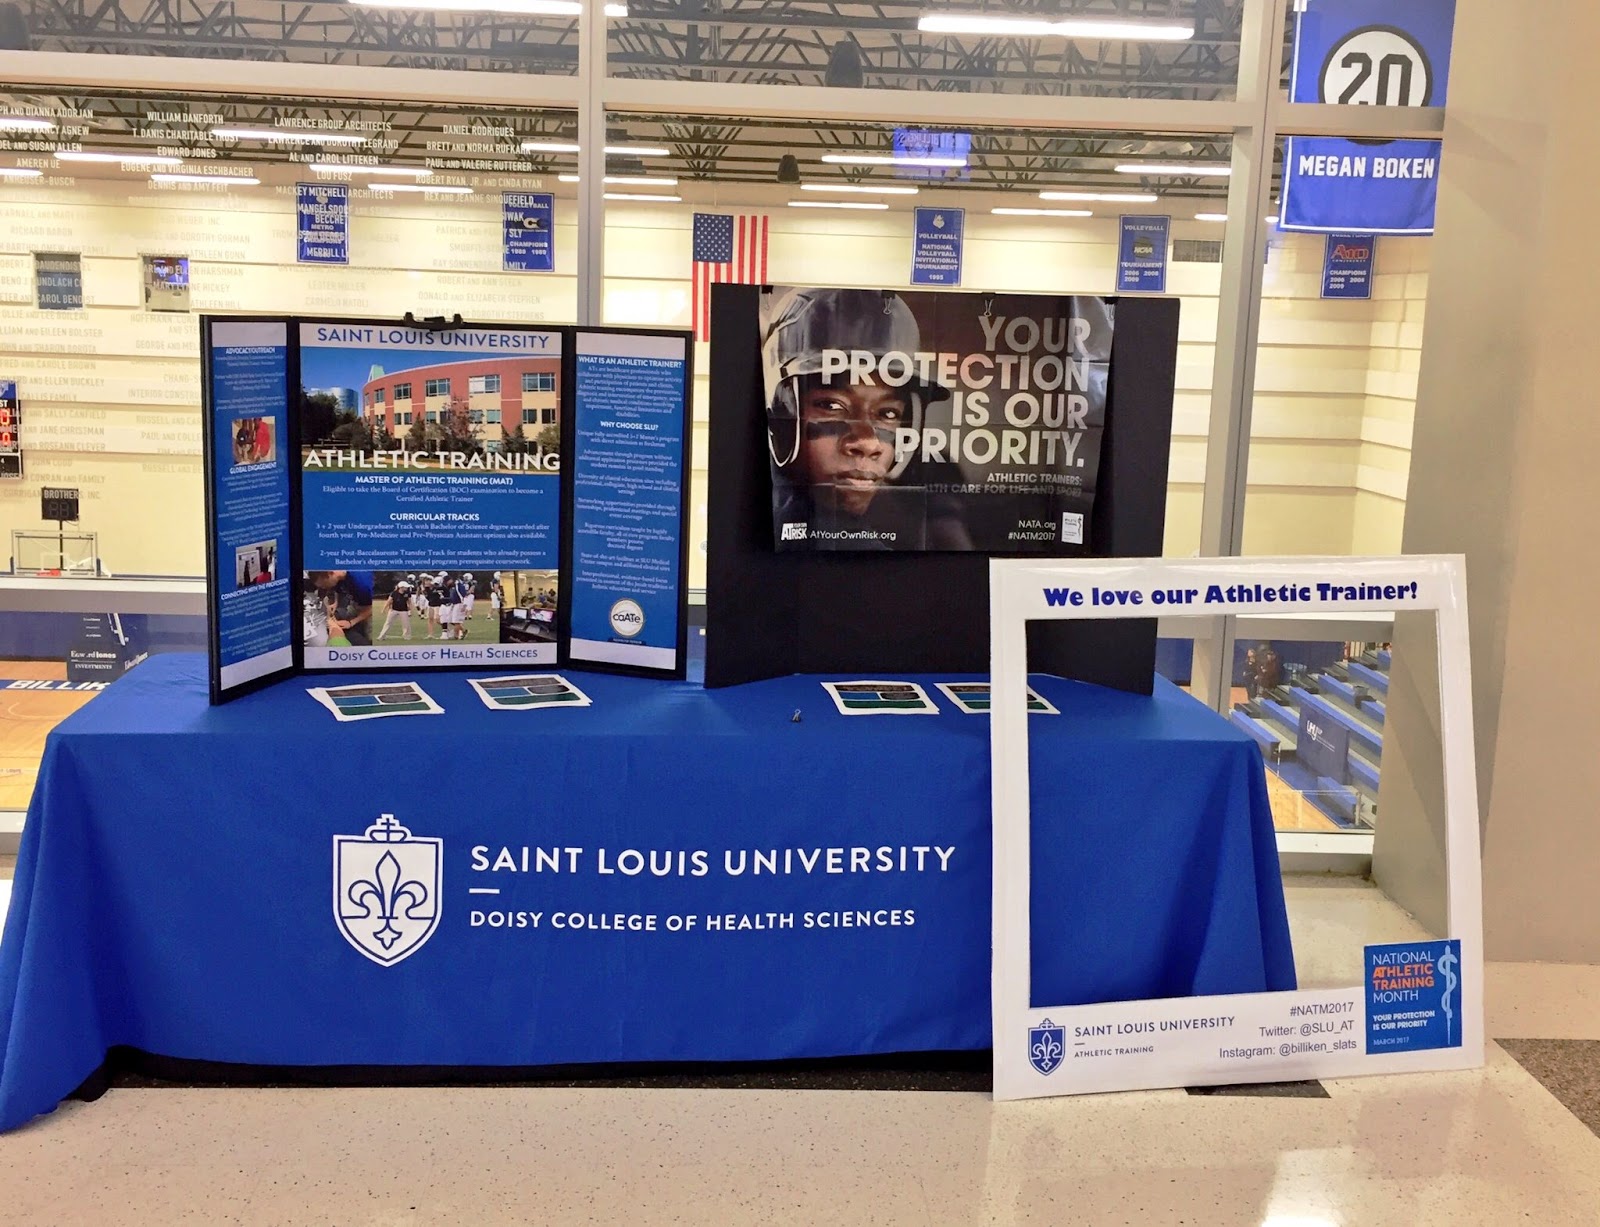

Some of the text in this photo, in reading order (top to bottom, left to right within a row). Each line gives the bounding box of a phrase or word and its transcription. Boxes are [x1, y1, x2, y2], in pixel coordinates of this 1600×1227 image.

[1338, 52, 1412, 107] 20
[10, 107, 93, 118] AND DIANNA ADORJAN
[147, 112, 224, 124] WILLIAM DANFORTH
[62, 126, 89, 135] AGNEW
[275, 117, 391, 131] LAWRENCE GROUP ARCHITECTS
[443, 125, 514, 136] DANIEL RODRIGUES
[141, 129, 164, 138] DANIS
[166, 130, 212, 140] CHARITABLE
[14, 141, 82, 152] AND SUSAN ALLEN
[158, 146, 216, 158] EDWARD JONES
[427, 141, 494, 153] BRETT AND NORMA
[16, 158, 60, 168] AMEREN UE
[289, 152, 299, 162] AL
[316, 153, 340, 163] CAROL
[343, 155, 378, 165] LITTEKEN
[426, 158, 532, 171] PAUL AND VALERIE RUTTERER
[121, 162, 253, 177] EUGENE AND VIRGINIA ESCHBACHER
[1299, 155, 1435, 179] MEGAN BOKEN
[317, 172, 352, 181] LOU FUSZ
[276, 186, 393, 199] MACKEY MITCHELL ARCHITECTS
[318, 327, 550, 349] SAINT LOUIS UNIVERSITY
[978, 315, 1091, 354] YOUR
[578, 356, 598, 364] WHAT
[617, 358, 648, 366] ATHLETIC
[649, 360, 682, 368] TRAINER?
[821, 349, 1089, 392] PROTECTION
[953, 391, 1088, 430] IS OUR
[616, 422, 643, 430] CHOOSE
[895, 427, 1085, 468] PRIORITY.
[303, 448, 561, 471] ATHLETIC TRAINING
[447, 477, 488, 485] TRAINING
[490, 477, 514, 485] (MAT)
[987, 473, 1082, 486] ATHLETIC TRAINERS:
[951, 483, 980, 494] CARE
[984, 484, 1006, 494] FOR
[1018, 520, 1056, 530] NATA.org
[809, 530, 897, 541] AtYourOwnRisk.org
[1008, 532, 1055, 540] #NATM2017
[1043, 582, 1418, 606] We love our Athletic Trainer!
[471, 845, 956, 877] SAINT LOUIS UNIVERSITY
[470, 910, 915, 932] DOISY COLLEGE OF HEALTH SCIENCES
[1373, 951, 1435, 965] NATIONAL
[1373, 963, 1433, 978] ATHLETIC
[1373, 976, 1435, 991] TRAINING
[1373, 990, 1419, 1003] MONTH
[1290, 1002, 1354, 1016] #NATM2017
[1372, 1010, 1435, 1022] YOUR PROTECTION
[1075, 1016, 1235, 1037] SAINT LOUIS UNIVERSITY
[1259, 1020, 1354, 1037] Twitter: @SLU_AT
[1381, 1022, 1396, 1030] OUR
[1397, 1020, 1428, 1028] PRIORITY
[1074, 1046, 1154, 1058] ATHLETIC TRAINING
[1220, 1040, 1357, 1059] Instagram: @billiken_slats
